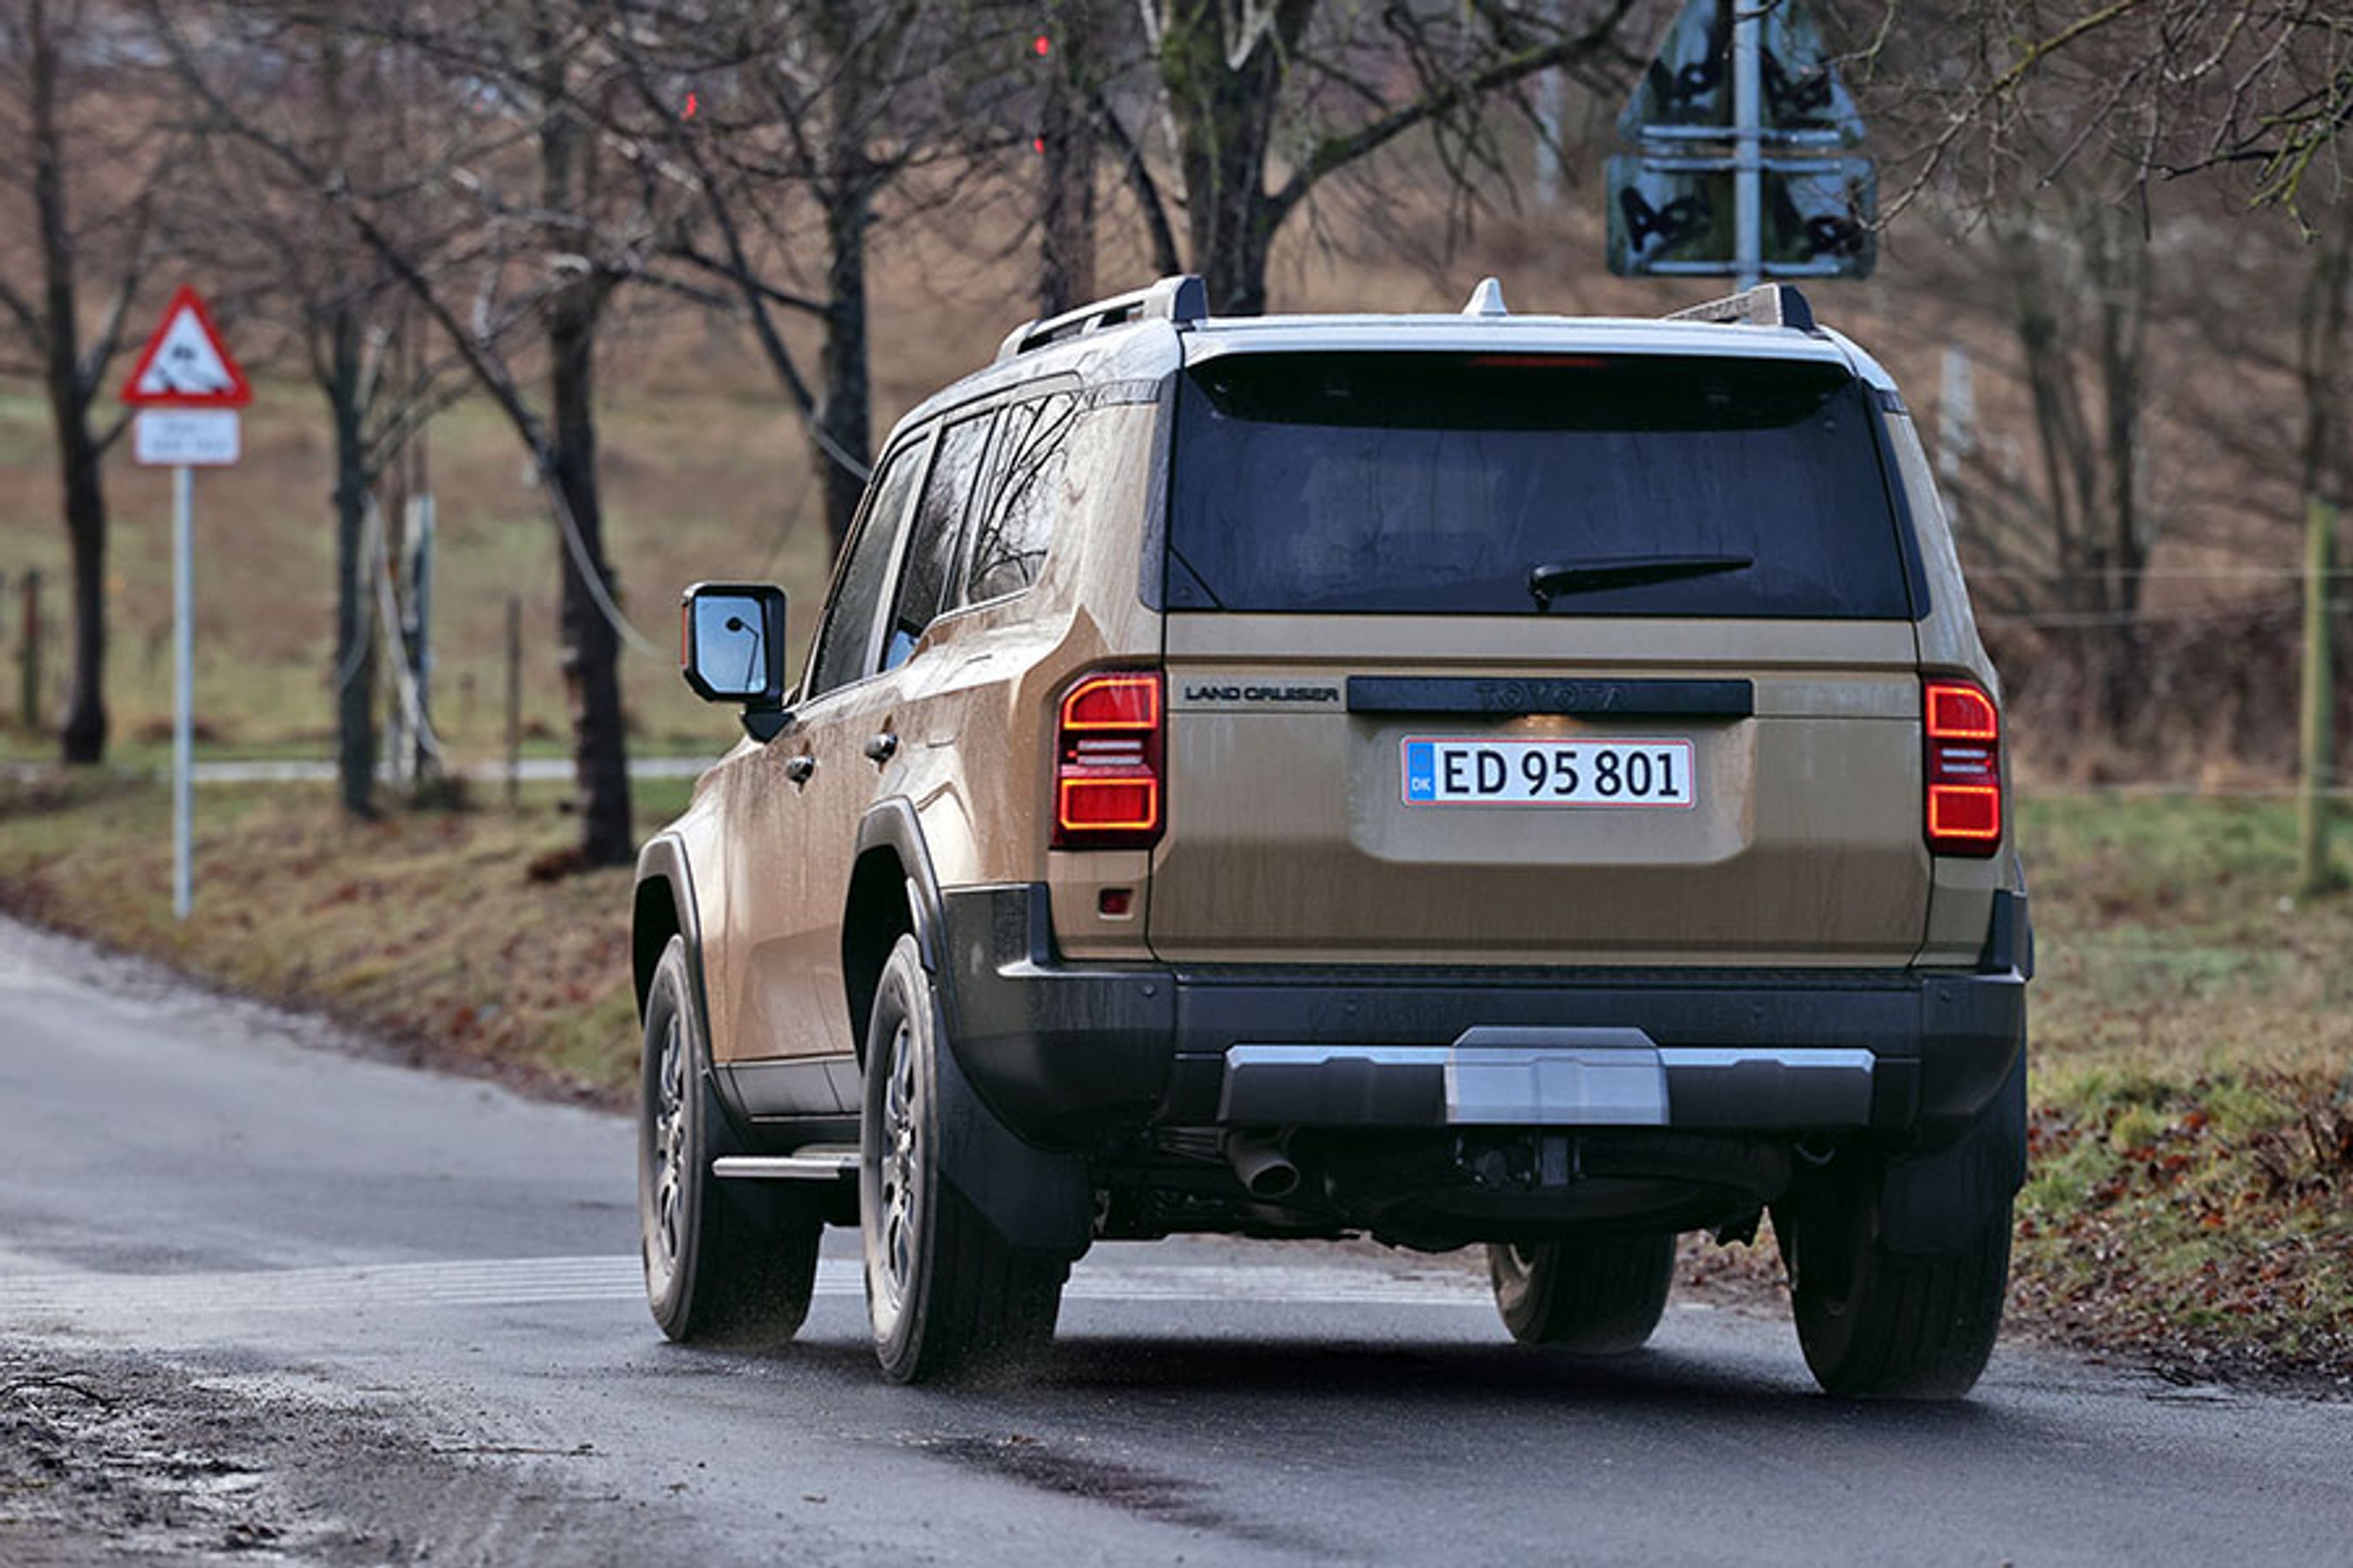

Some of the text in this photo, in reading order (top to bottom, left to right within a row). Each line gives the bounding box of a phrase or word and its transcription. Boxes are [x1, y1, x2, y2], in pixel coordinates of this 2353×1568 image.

[1184, 686, 1340, 702] LAND CRUISER
[1443, 750, 1679, 798] ED 95 801
[1412, 777, 1431, 791] DK
